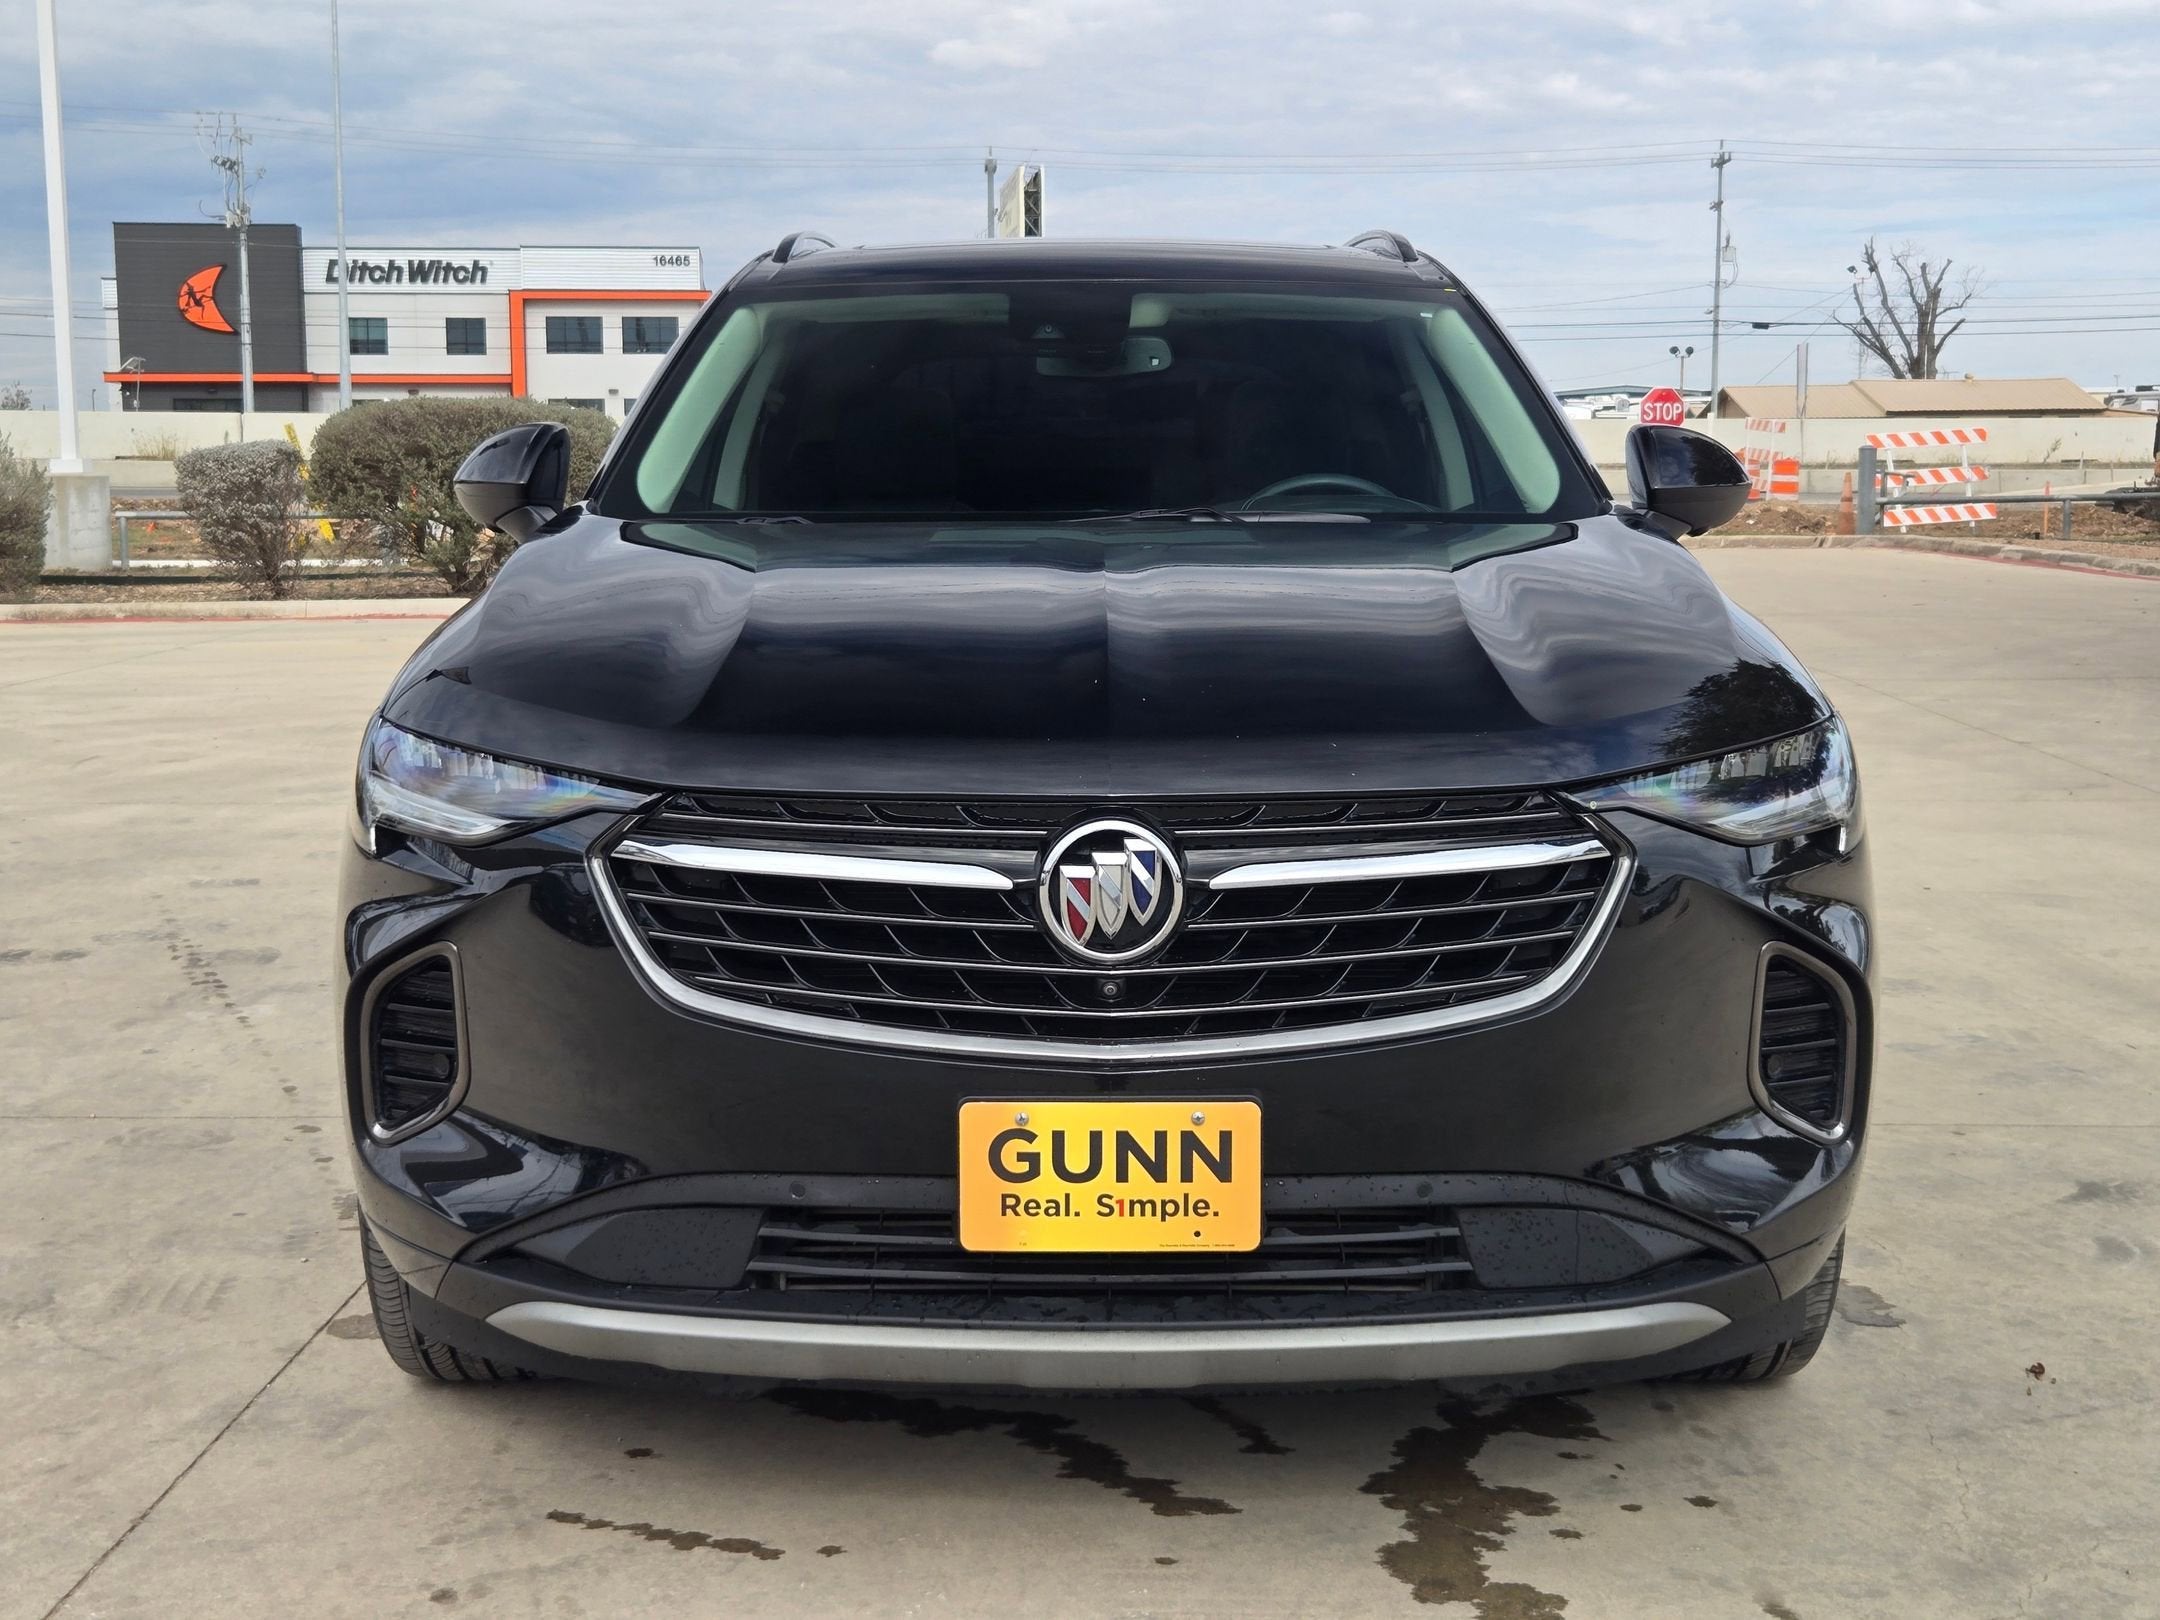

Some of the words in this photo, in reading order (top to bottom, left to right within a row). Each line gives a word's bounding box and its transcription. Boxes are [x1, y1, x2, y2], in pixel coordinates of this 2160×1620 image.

[325, 258, 404, 284] Ditch
[407, 259, 489, 284] Witch
[653, 255, 691, 267] 16465
[1643, 402, 1682, 421] STOP
[988, 1127, 1233, 1184] GUNN
[1000, 1192, 1081, 1217] Real.
